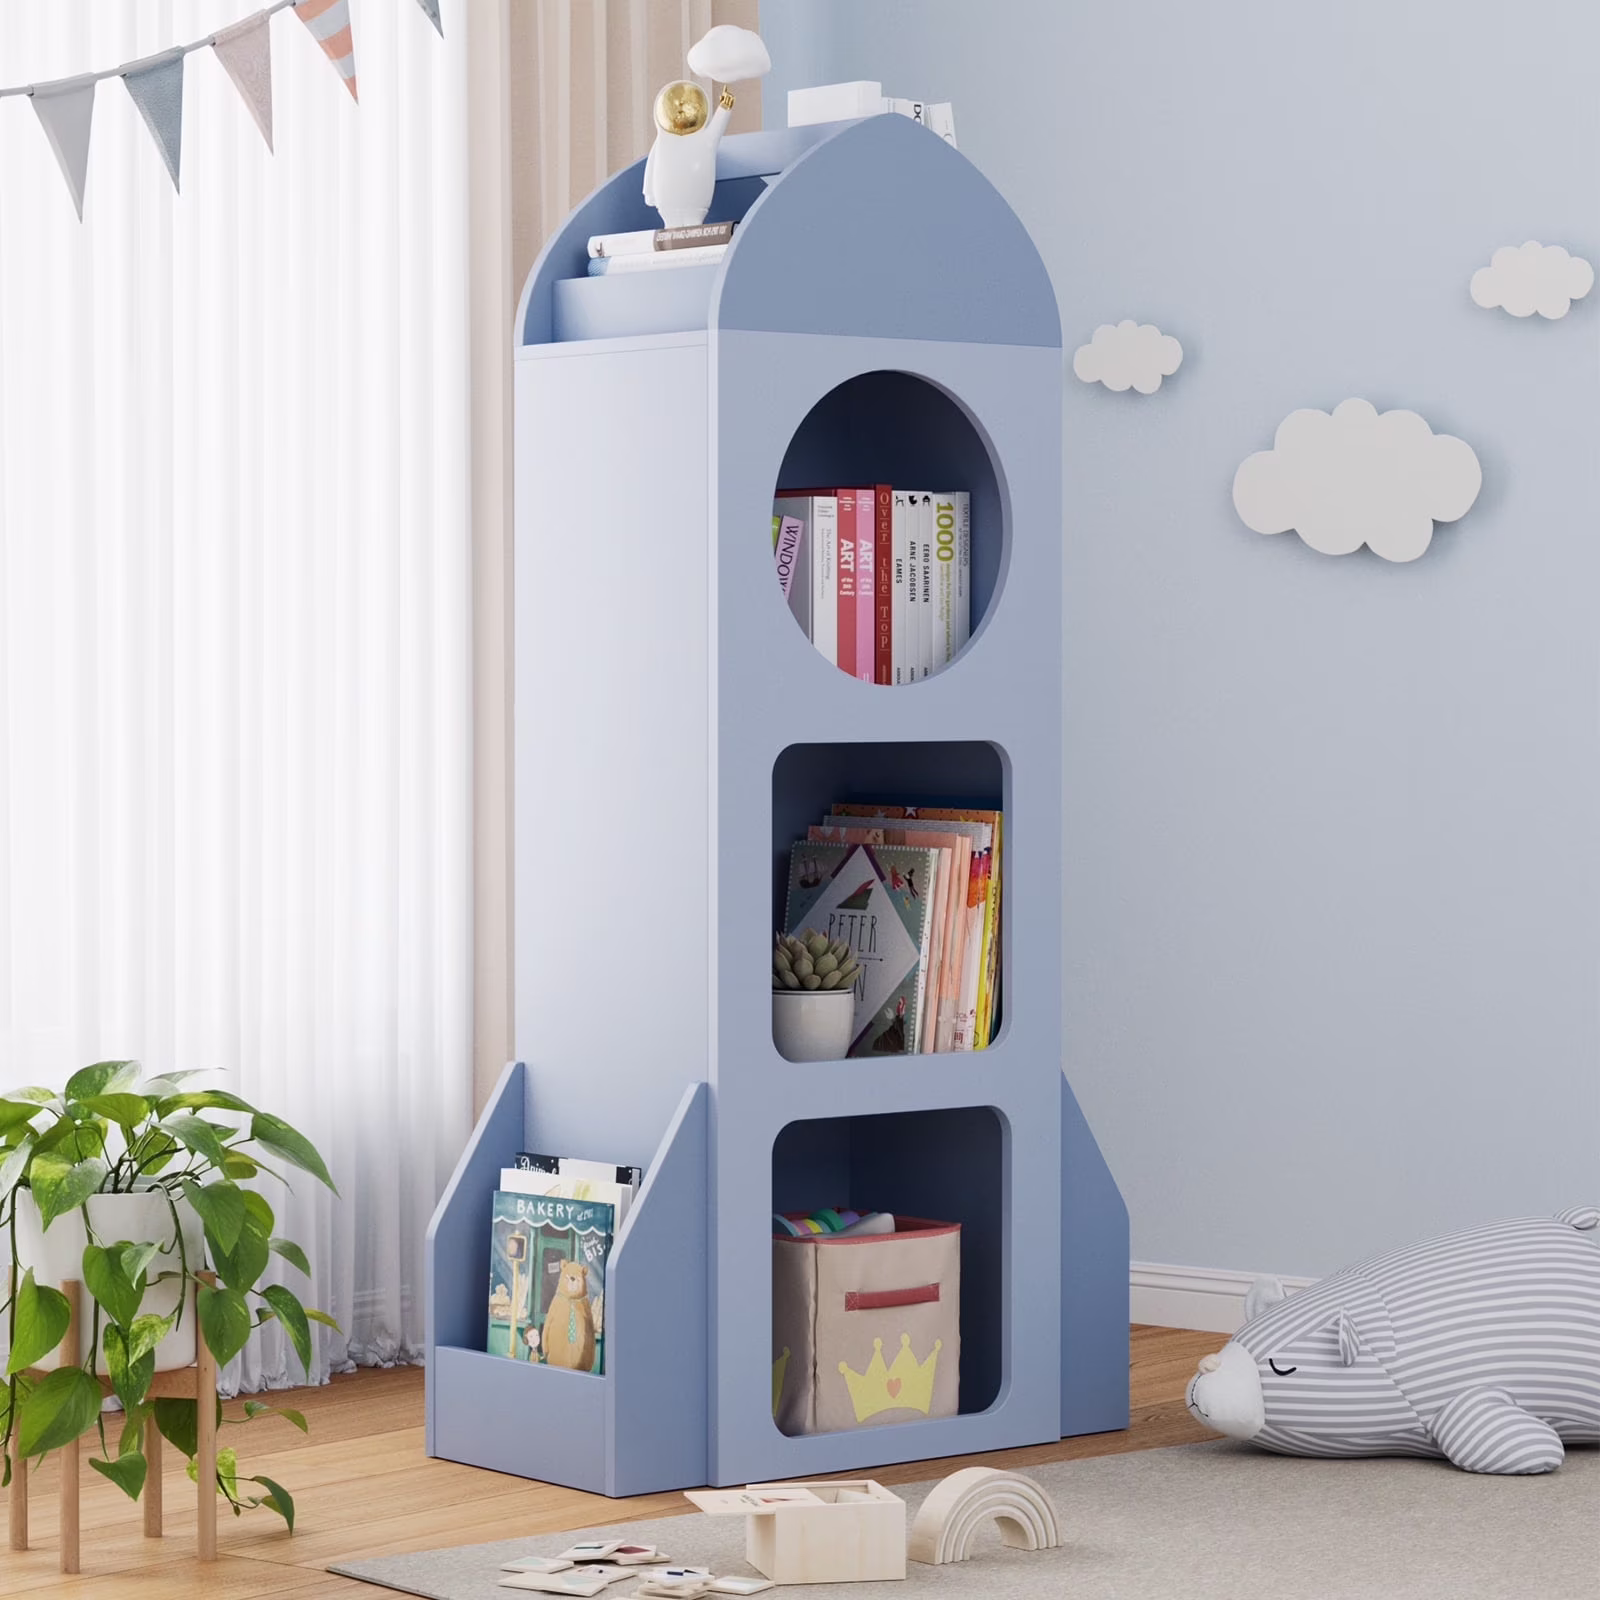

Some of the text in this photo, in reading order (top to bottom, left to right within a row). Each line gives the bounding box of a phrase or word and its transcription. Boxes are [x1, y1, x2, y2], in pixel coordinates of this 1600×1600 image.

[936, 502, 954, 562] 1000
[840, 539, 855, 572] ART
[859, 539, 873, 572] ART
[880, 558, 888, 593] the
[516, 1199, 575, 1220] BAKERY
